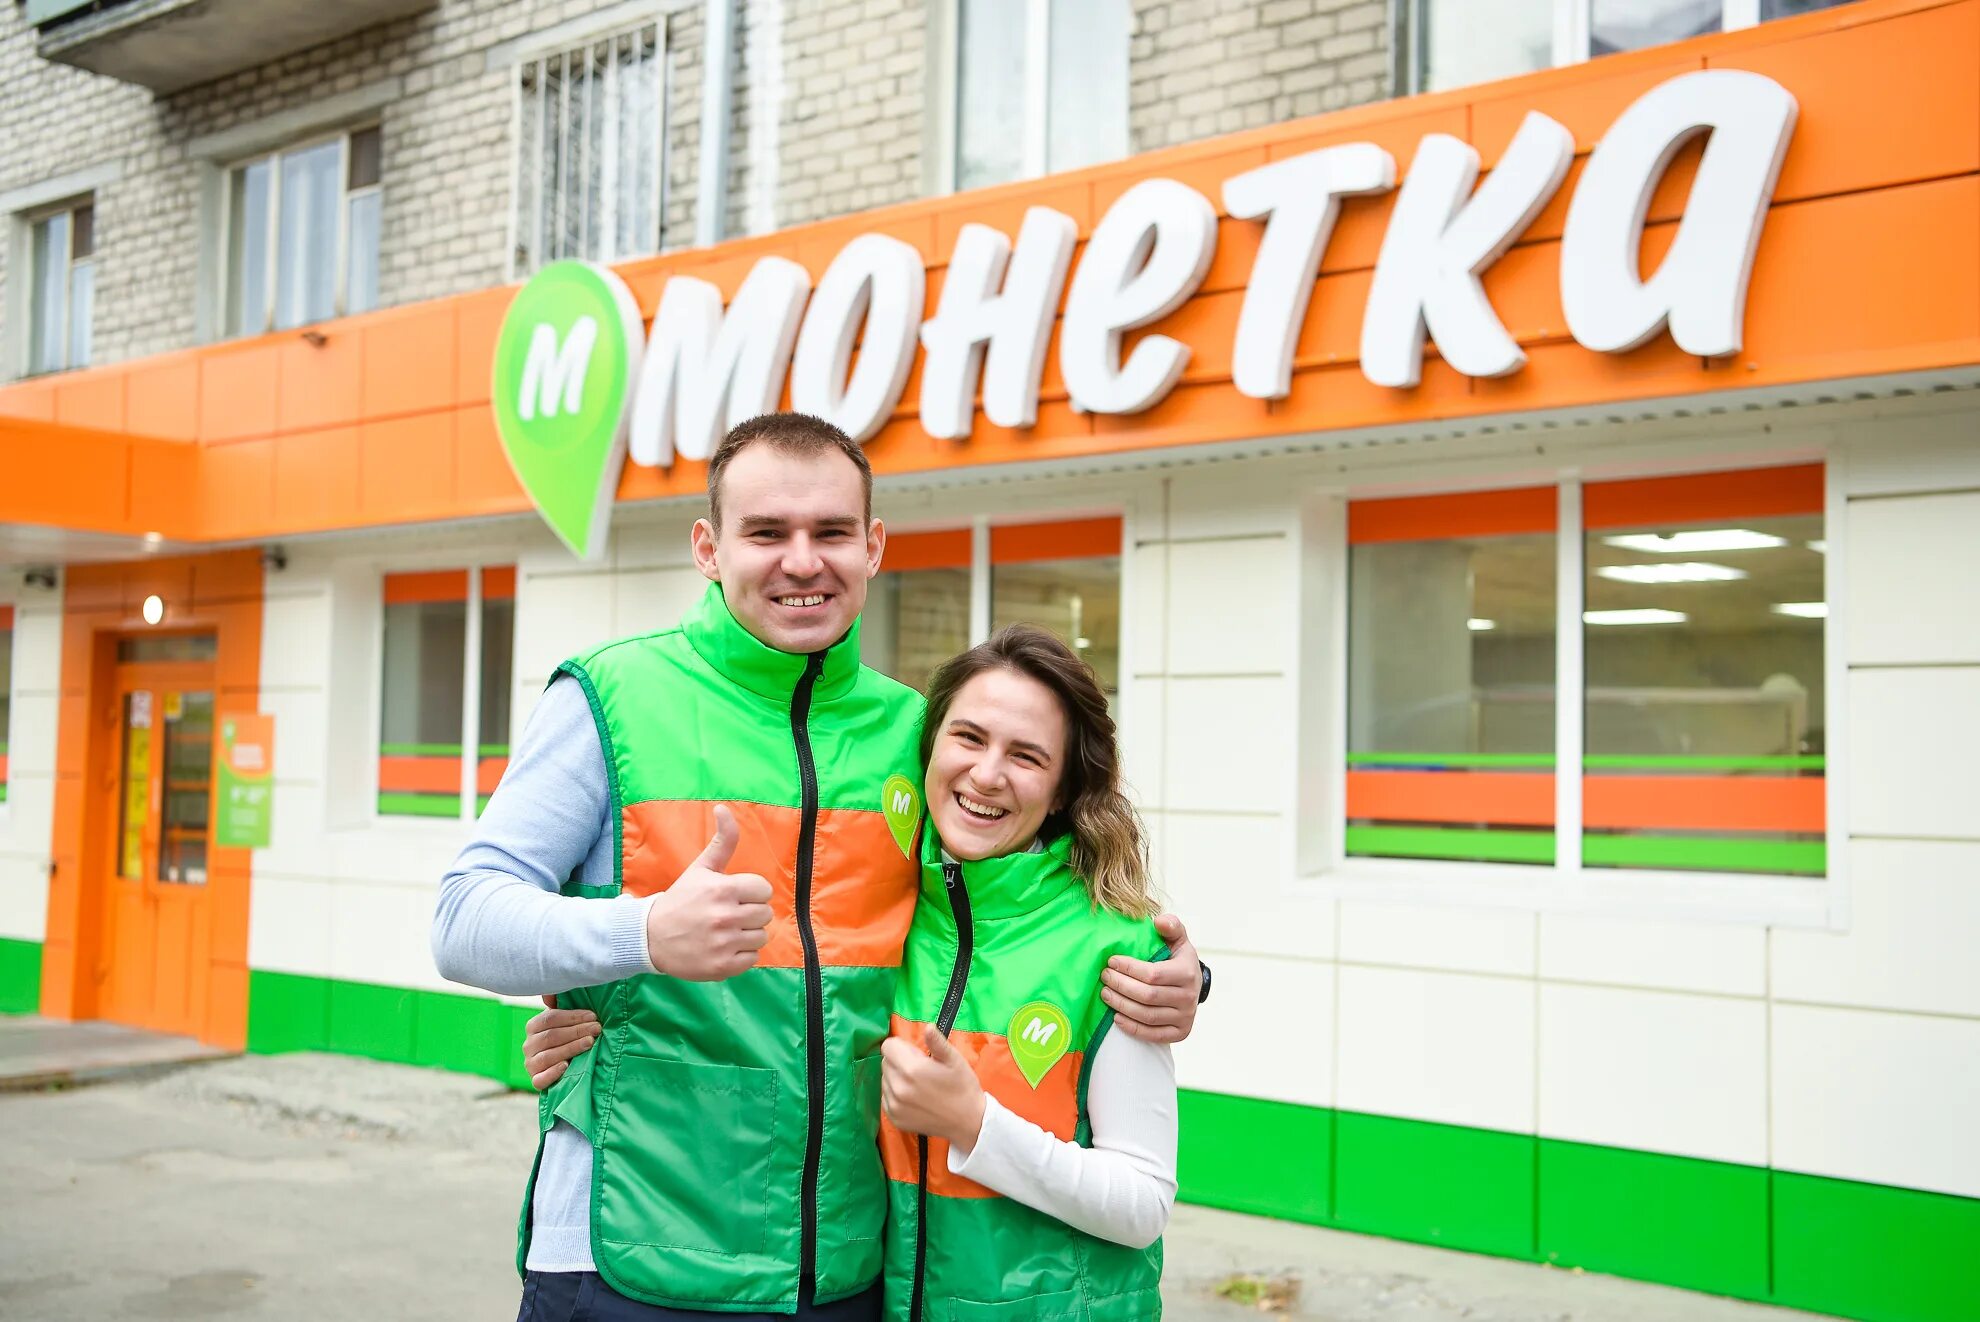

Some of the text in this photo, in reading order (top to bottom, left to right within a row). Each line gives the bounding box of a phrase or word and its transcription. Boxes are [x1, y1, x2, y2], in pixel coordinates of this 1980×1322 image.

[518, 315, 598, 421] М
[892, 789, 911, 815] М
[1021, 1016, 1059, 1046] М
